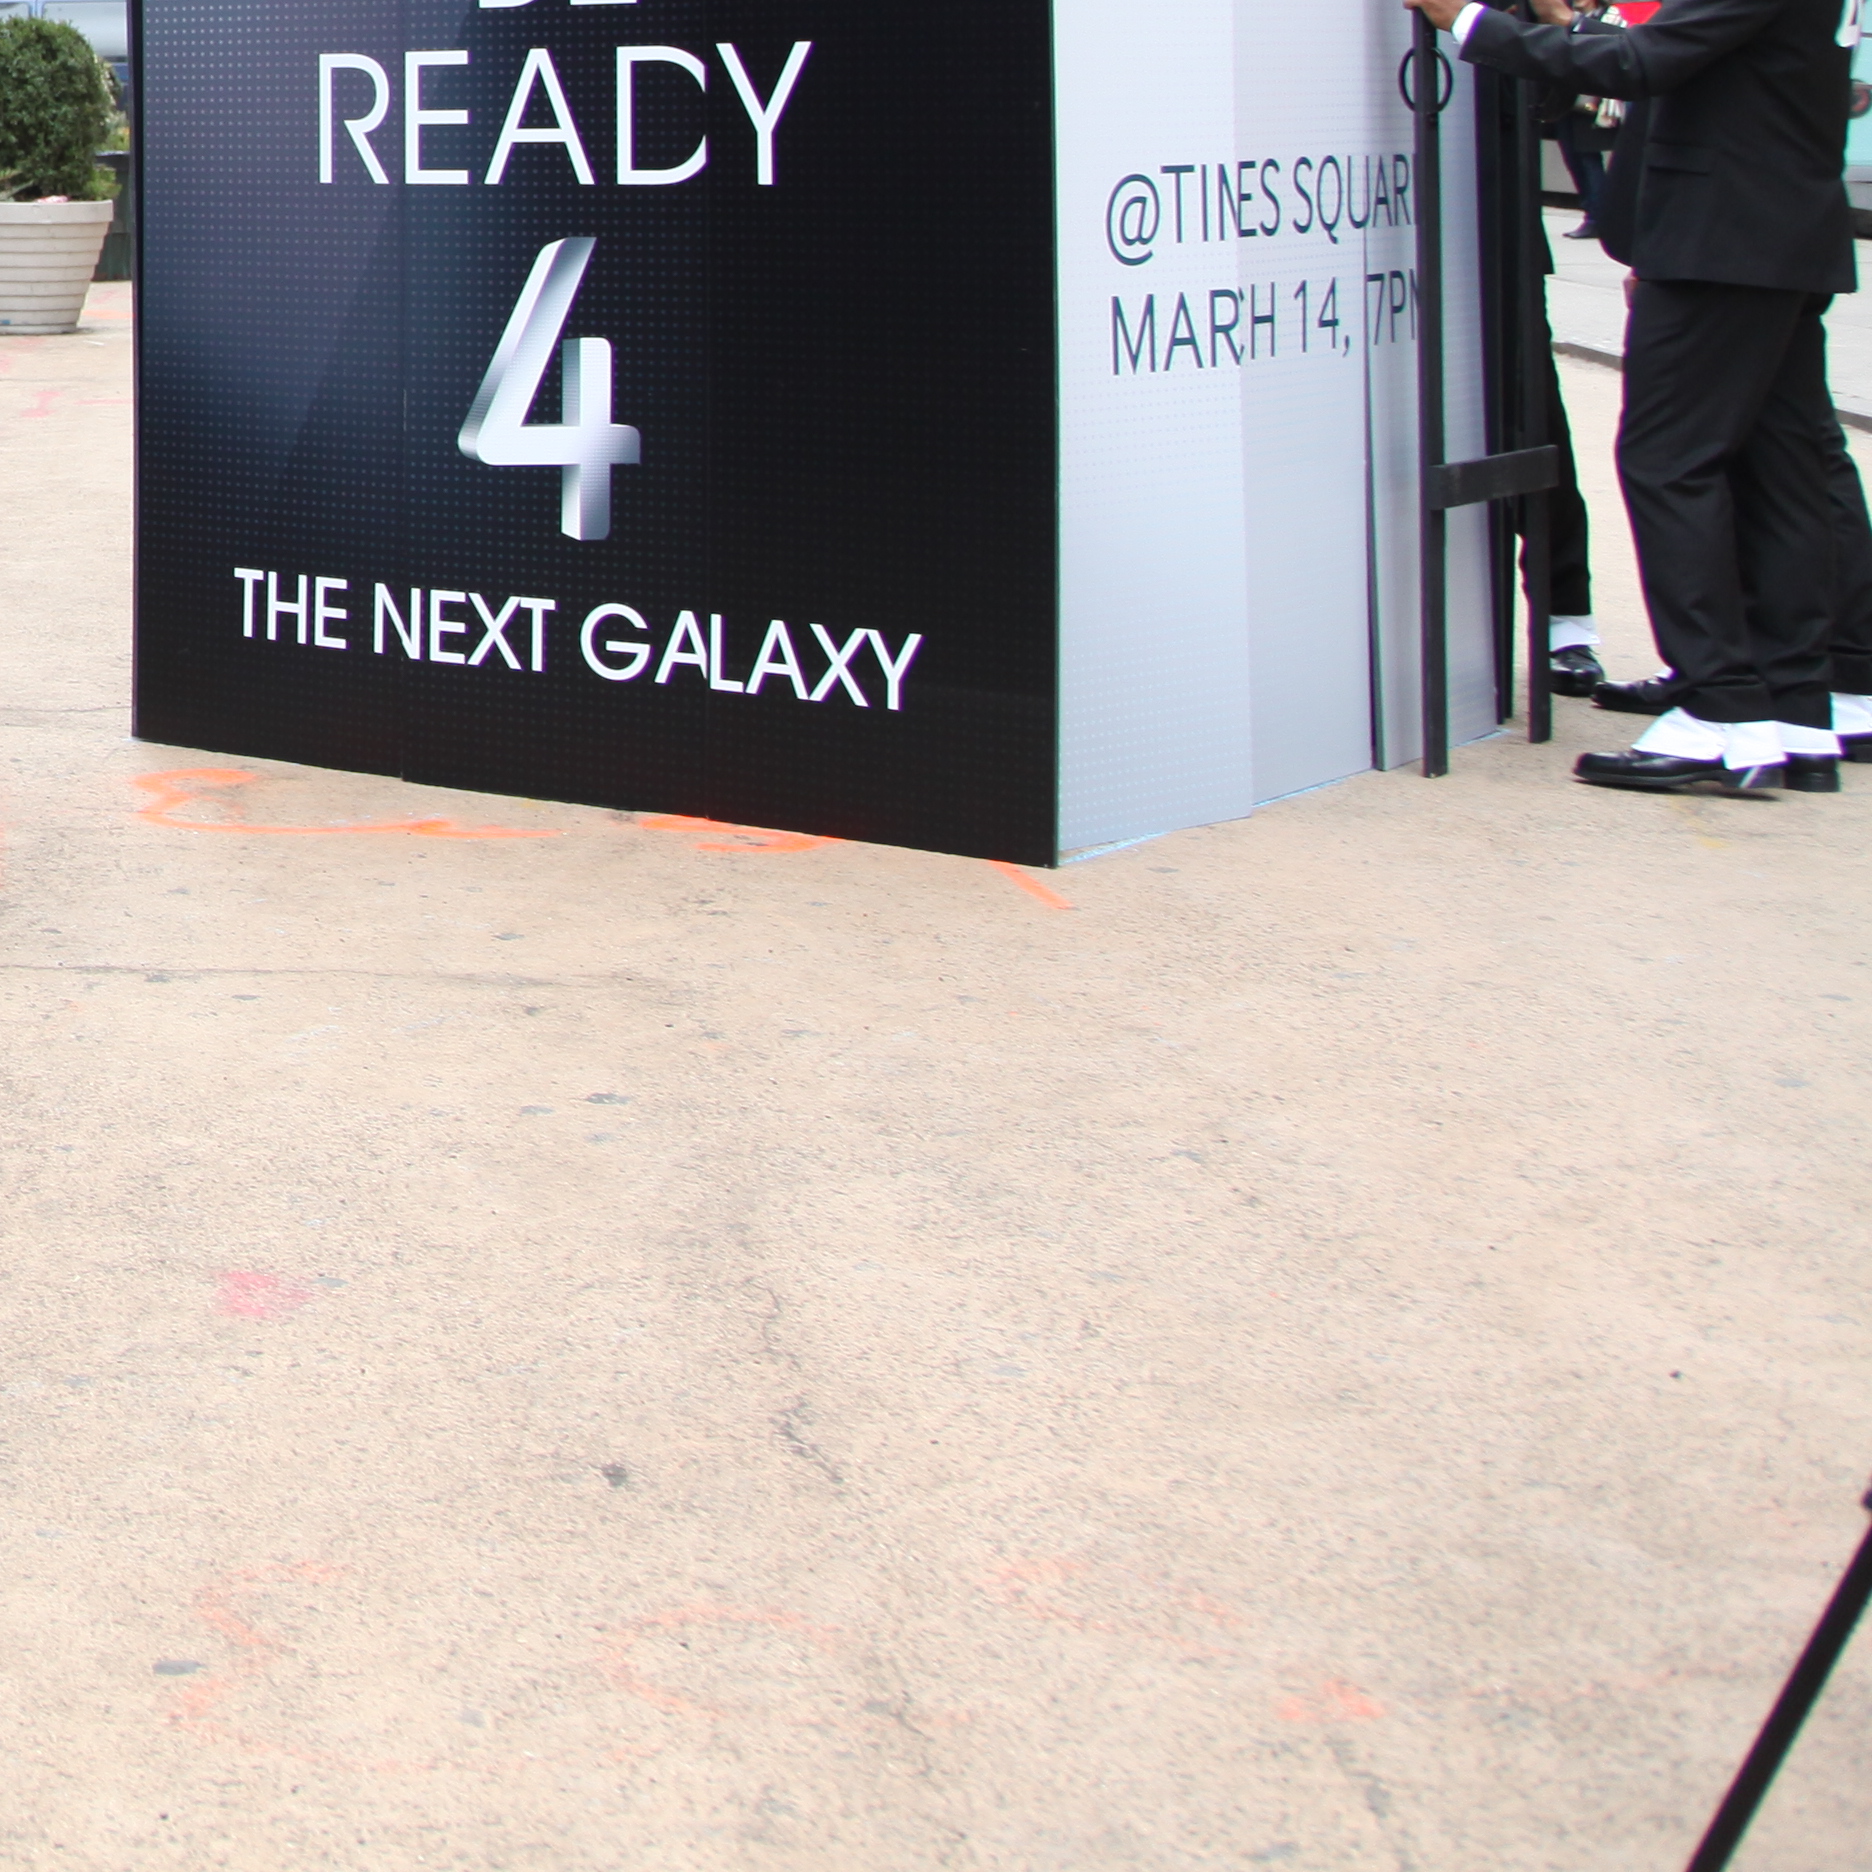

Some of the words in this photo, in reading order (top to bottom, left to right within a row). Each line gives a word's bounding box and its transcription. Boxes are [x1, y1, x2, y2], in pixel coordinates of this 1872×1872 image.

[318, 41, 812, 186] READY
[1292, 153, 1418, 245] SQUAR
[457, 235, 642, 541] 4
[1110, 281, 1276, 376] MARH
[1293, 276, 1351, 358] 14,
[234, 565, 347, 650] THE
[372, 580, 555, 672] NEXT
[579, 602, 922, 712] GALAXY
